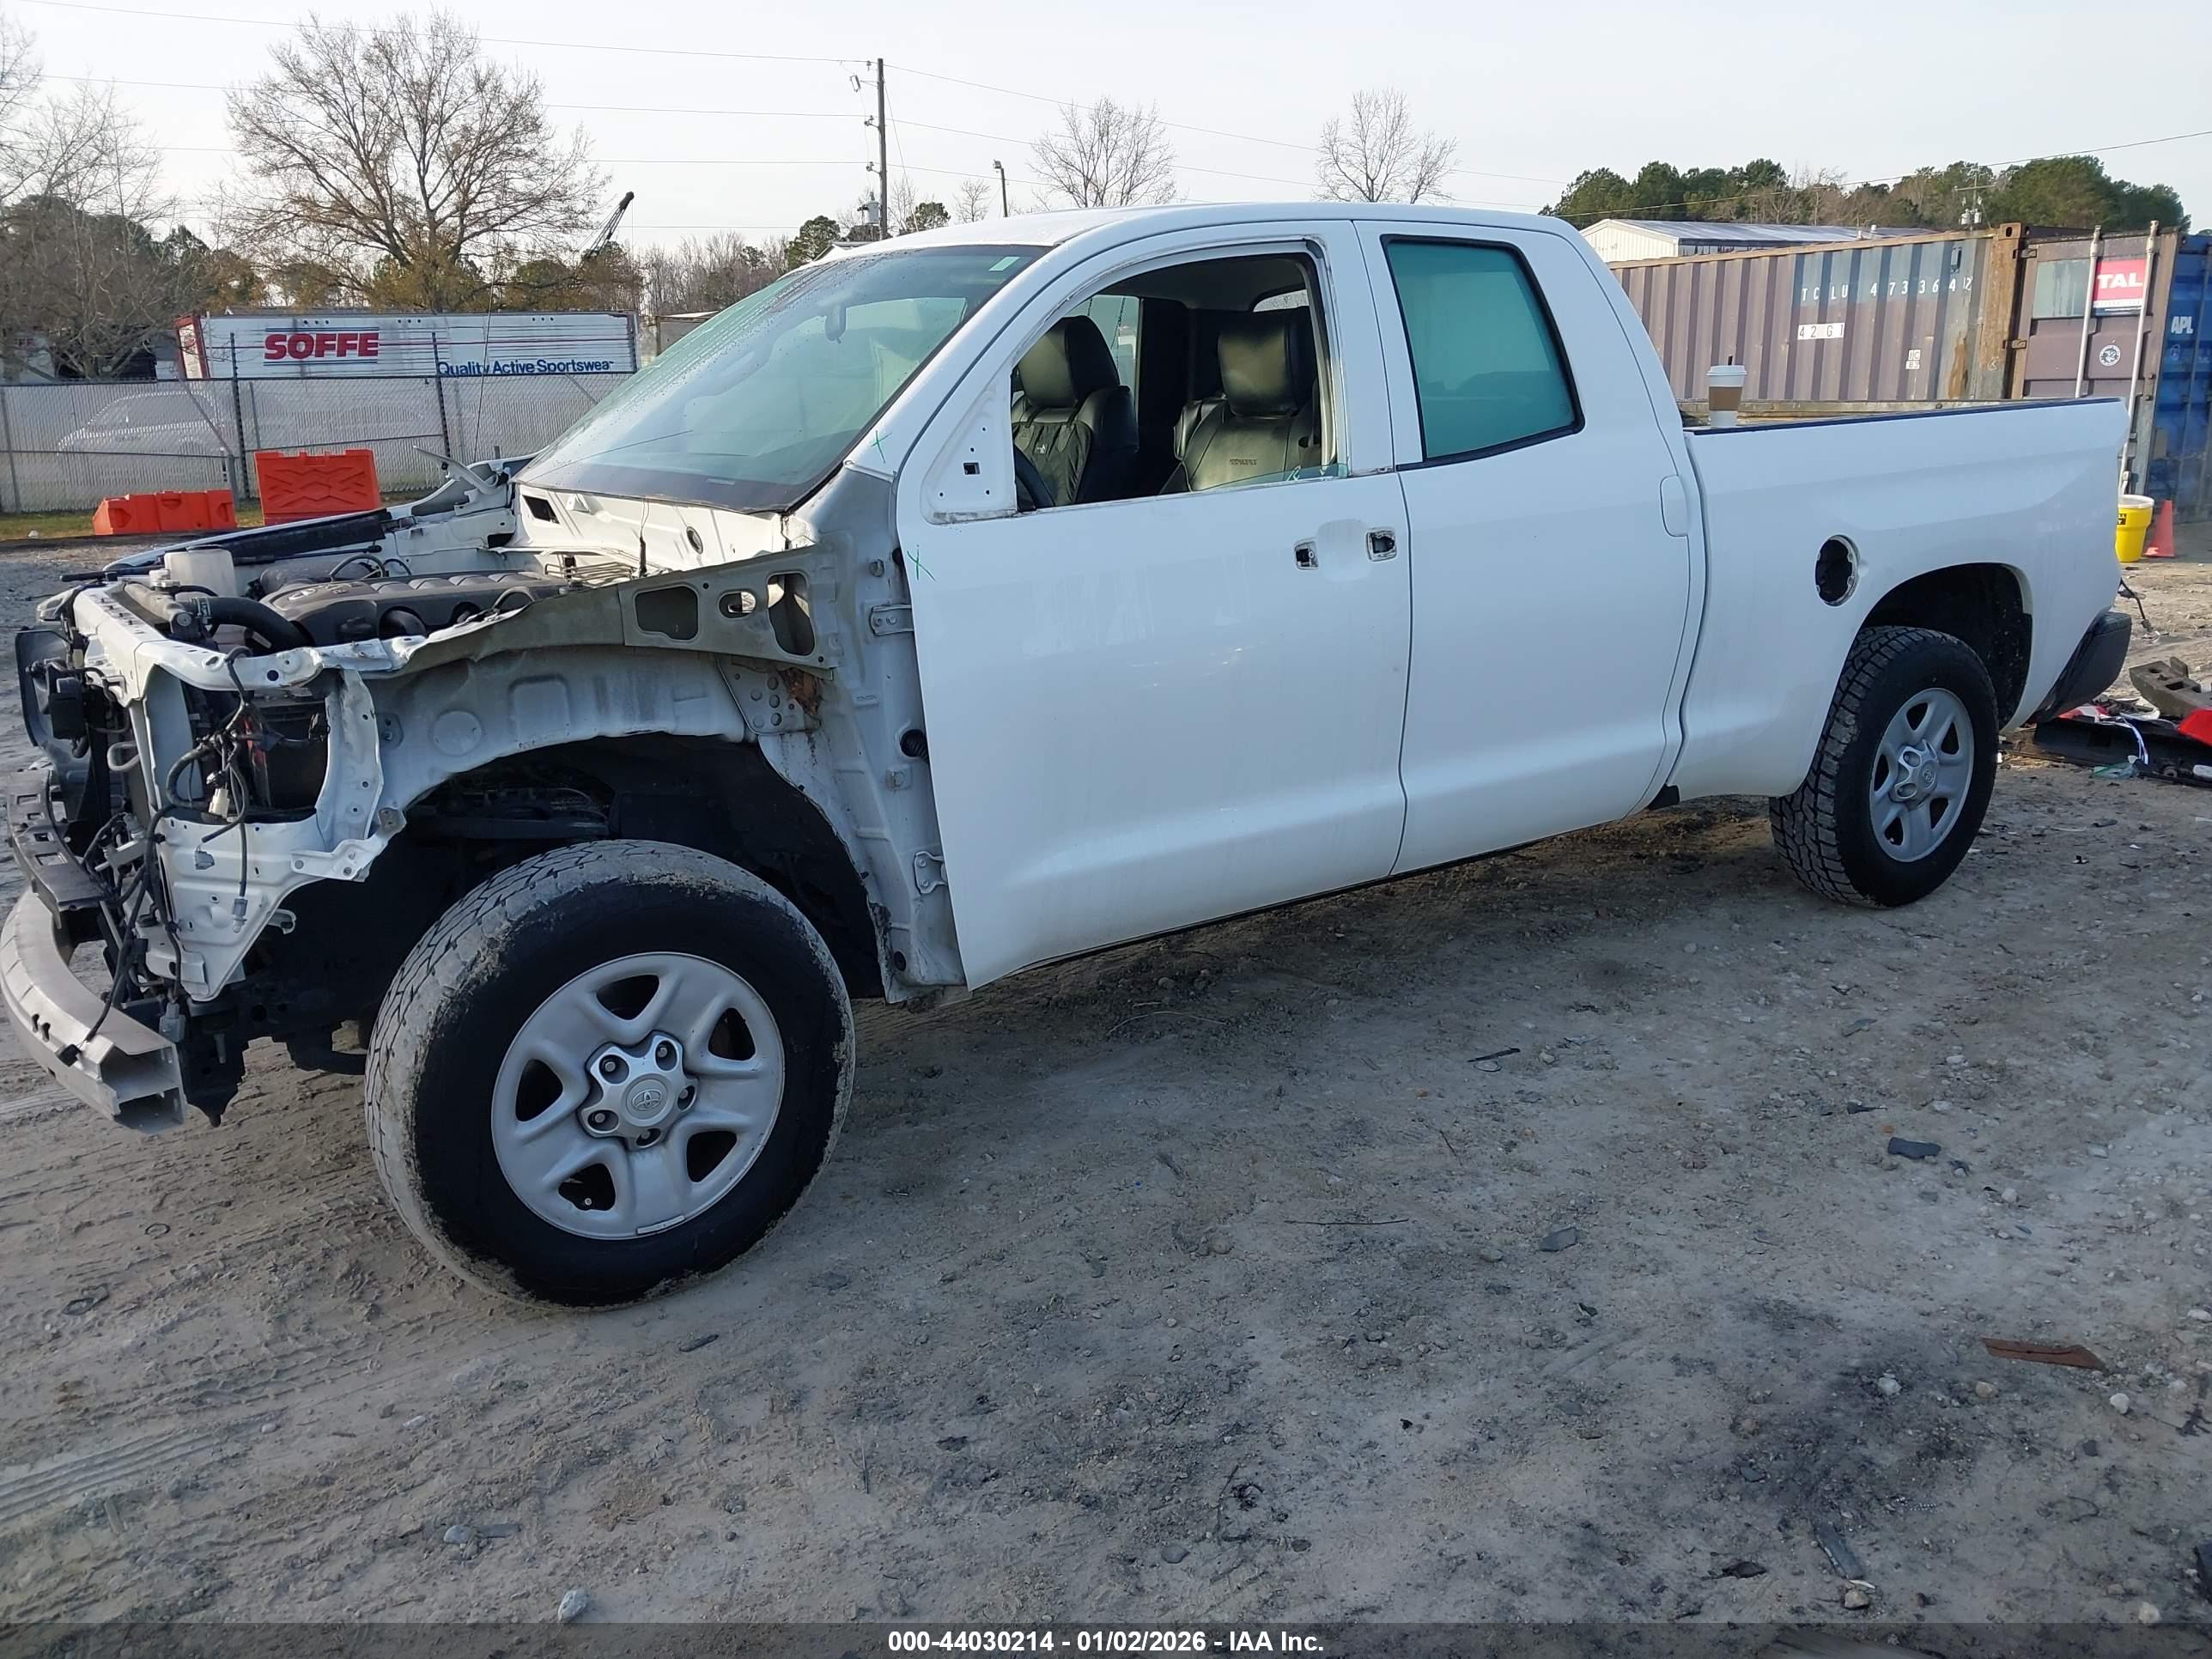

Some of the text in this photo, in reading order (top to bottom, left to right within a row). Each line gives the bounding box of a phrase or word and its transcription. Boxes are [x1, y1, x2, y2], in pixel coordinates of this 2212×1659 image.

[2097, 272, 2143, 289] TAL
[1802, 284, 1849, 301] TCLU
[2171, 316, 2194, 335] APL
[264, 333, 380, 360] SOFFE
[438, 361, 490, 375] Quality
[492, 359, 534, 374] Active
